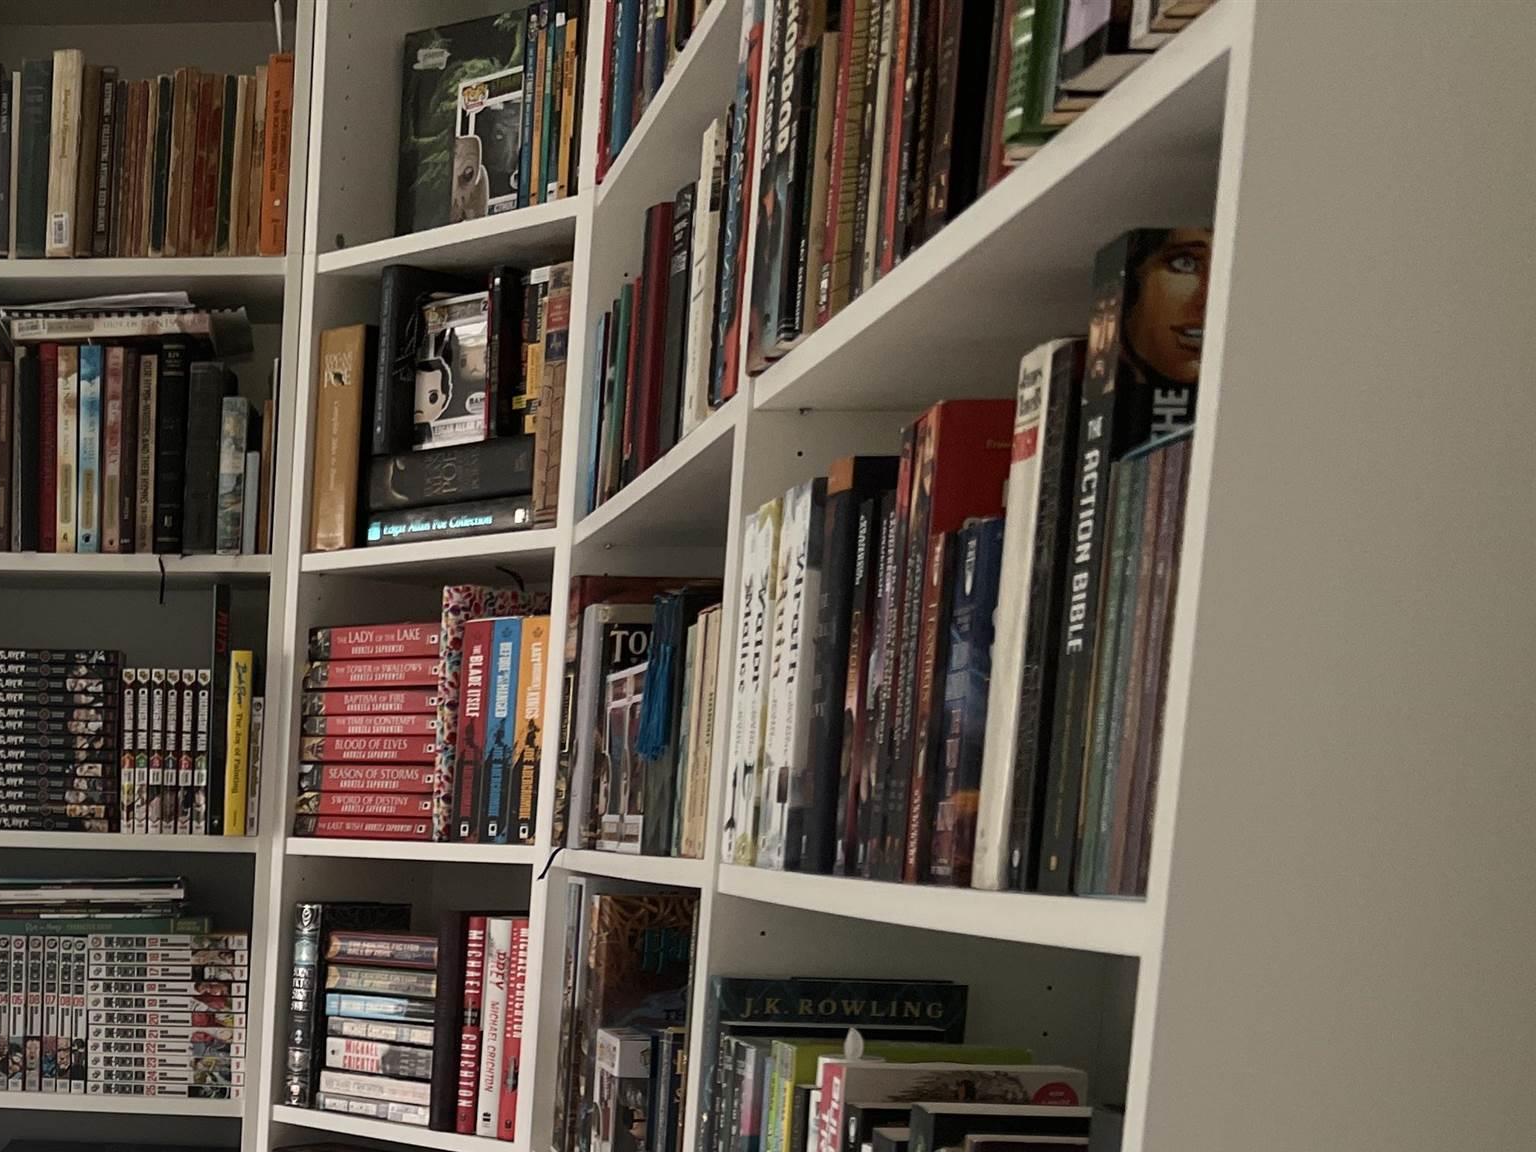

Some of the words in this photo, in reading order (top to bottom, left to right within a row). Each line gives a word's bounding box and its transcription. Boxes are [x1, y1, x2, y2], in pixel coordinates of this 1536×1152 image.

[1075, 449, 1100, 563] ACTION
[1066, 572, 1090, 656] BIBLE
[348, 631, 374, 644] LADY
[397, 628, 421, 641] LAKE
[0, 650, 25, 660] SLAYER
[0, 664, 25, 674] SLAYER
[334, 739, 365, 750] BLOOD
[368, 739, 380, 750] OF
[383, 739, 408, 750] ELVES
[328, 768, 363, 779] SEASON
[366, 769, 378, 779] OF
[381, 769, 419, 780] STORMS
[465, 929, 484, 995] MICHAEL
[798, 998, 945, 1018] ROWLING
[344, 1040, 380, 1058] MICHAEL
[457, 1033, 477, 1107] CRICHTON
